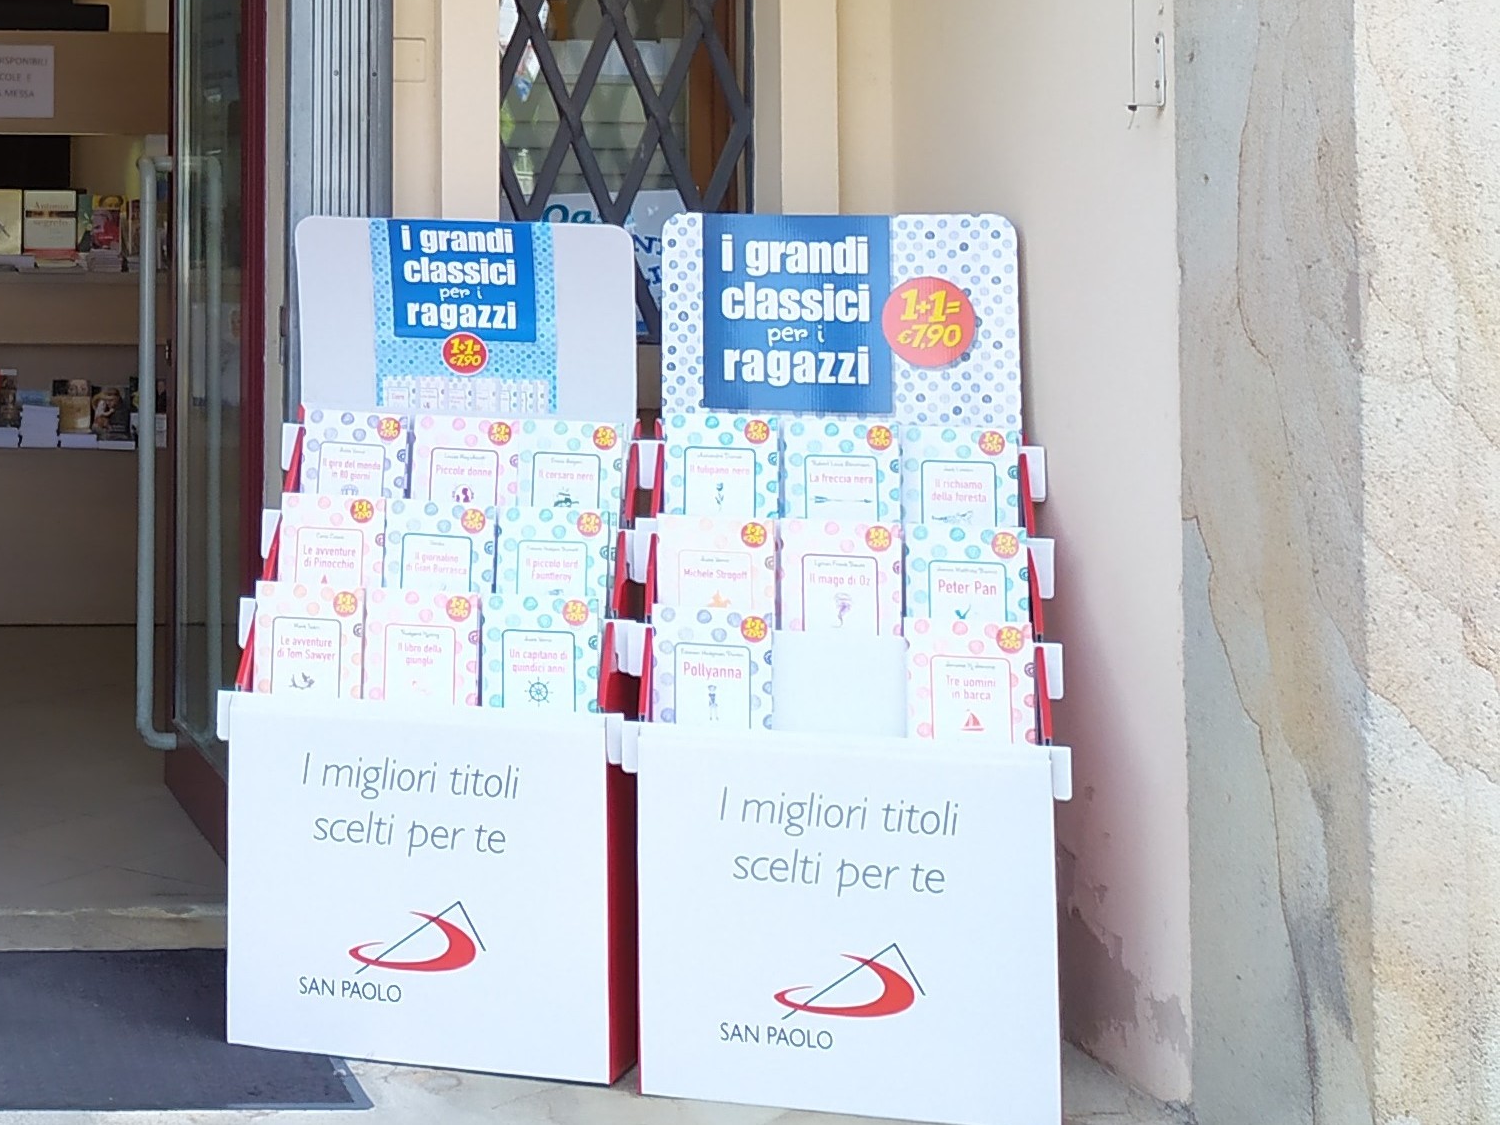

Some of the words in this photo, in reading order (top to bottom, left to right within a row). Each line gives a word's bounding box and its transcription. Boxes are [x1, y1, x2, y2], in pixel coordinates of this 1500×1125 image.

[401, 225, 412, 251] i
[419, 226, 514, 255] grandi
[721, 234, 733, 272] i
[745, 235, 869, 276] grandi
[403, 257, 517, 286] classici
[439, 286, 470, 302] per
[721, 282, 870, 322] classici
[900, 288, 961, 323] 1+1=
[406, 300, 517, 331] ragazzi
[767, 323, 808, 347] per
[723, 346, 870, 387] ragazzi
[436, 464, 465, 476] Piccole
[468, 466, 492, 476] donne
[545, 470, 574, 480] corsaro
[576, 472, 594, 481] nero
[810, 473, 819, 482] La
[822, 473, 851, 483] freccia
[854, 475, 873, 484] nera
[944, 479, 982, 490] richiamo
[932, 492, 952, 502] della
[955, 492, 986, 503] foresta
[303, 544, 313, 555] Le
[316, 546, 356, 557] avventure
[304, 557, 311, 567] di
[314, 557, 354, 569] Pinocchio
[532, 559, 560, 570] piccolo
[684, 568, 713, 579] Michele
[716, 569, 747, 581] Strogoff
[818, 575, 844, 587] mago
[848, 575, 856, 585] di
[860, 575, 870, 586] Oz
[938, 578, 970, 595] Peter
[974, 580, 997, 595] Pan
[280, 635, 290, 646] Le
[292, 637, 332, 647] avventure
[404, 642, 421, 653] libro
[424, 644, 442, 653] della
[276, 647, 284, 658] di
[287, 648, 302, 659] Tom
[305, 649, 336, 662] Sawyer
[406, 655, 433, 667] giungla
[510, 649, 520, 658] Un
[522, 650, 558, 661] capitano
[560, 651, 568, 660] di
[512, 663, 545, 674] quindici
[548, 665, 565, 673] anni
[683, 661, 742, 681] Pollyanna
[946, 674, 960, 685] Tre
[963, 678, 996, 687] uomini
[952, 690, 960, 699] in
[964, 688, 991, 700] barca
[303, 752, 310, 784] I
[322, 756, 437, 800] migliori
[450, 762, 520, 800] titoli
[720, 786, 728, 821] I
[742, 792, 868, 837] migliori
[882, 800, 959, 836] titoli
[313, 810, 395, 846] scelti
[407, 820, 466, 857] per
[475, 824, 506, 854] te
[733, 848, 822, 885] scelti
[836, 858, 900, 897] per
[910, 863, 945, 894] te
[299, 976, 335, 997] SAN
[341, 979, 402, 1003] PAOLO
[720, 1022, 759, 1044] SAN
[767, 1026, 833, 1050] PAOLO
